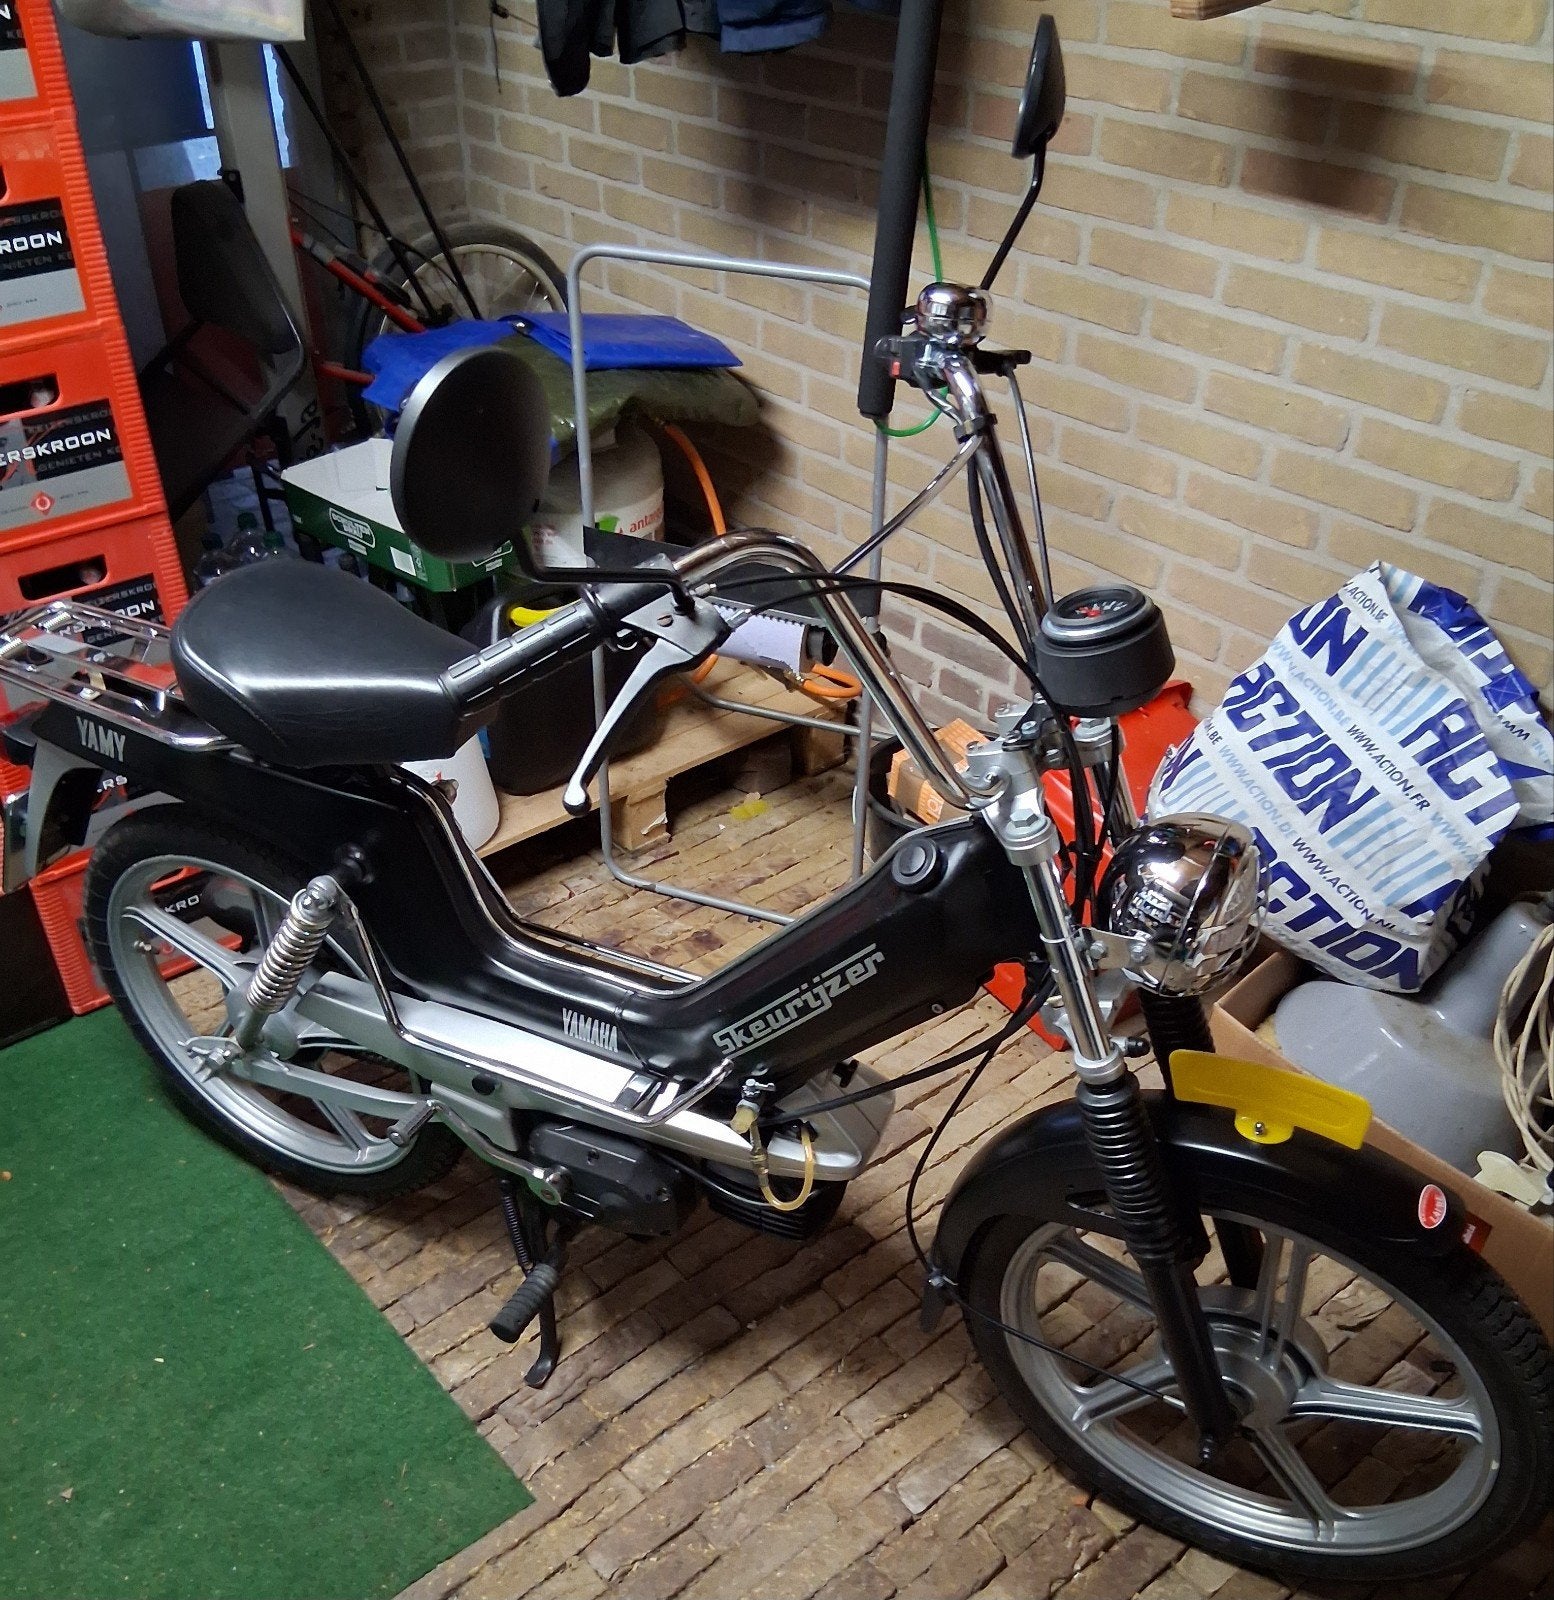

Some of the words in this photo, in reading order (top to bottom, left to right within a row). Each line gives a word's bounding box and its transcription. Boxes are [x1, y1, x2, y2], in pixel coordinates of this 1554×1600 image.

[75, 715, 126, 763] YAMY
[1221, 660, 1382, 836] ACTION
[1346, 723, 1431, 812] WWW.ACTION.FR
[561, 1007, 620, 1054] YAMAHA
